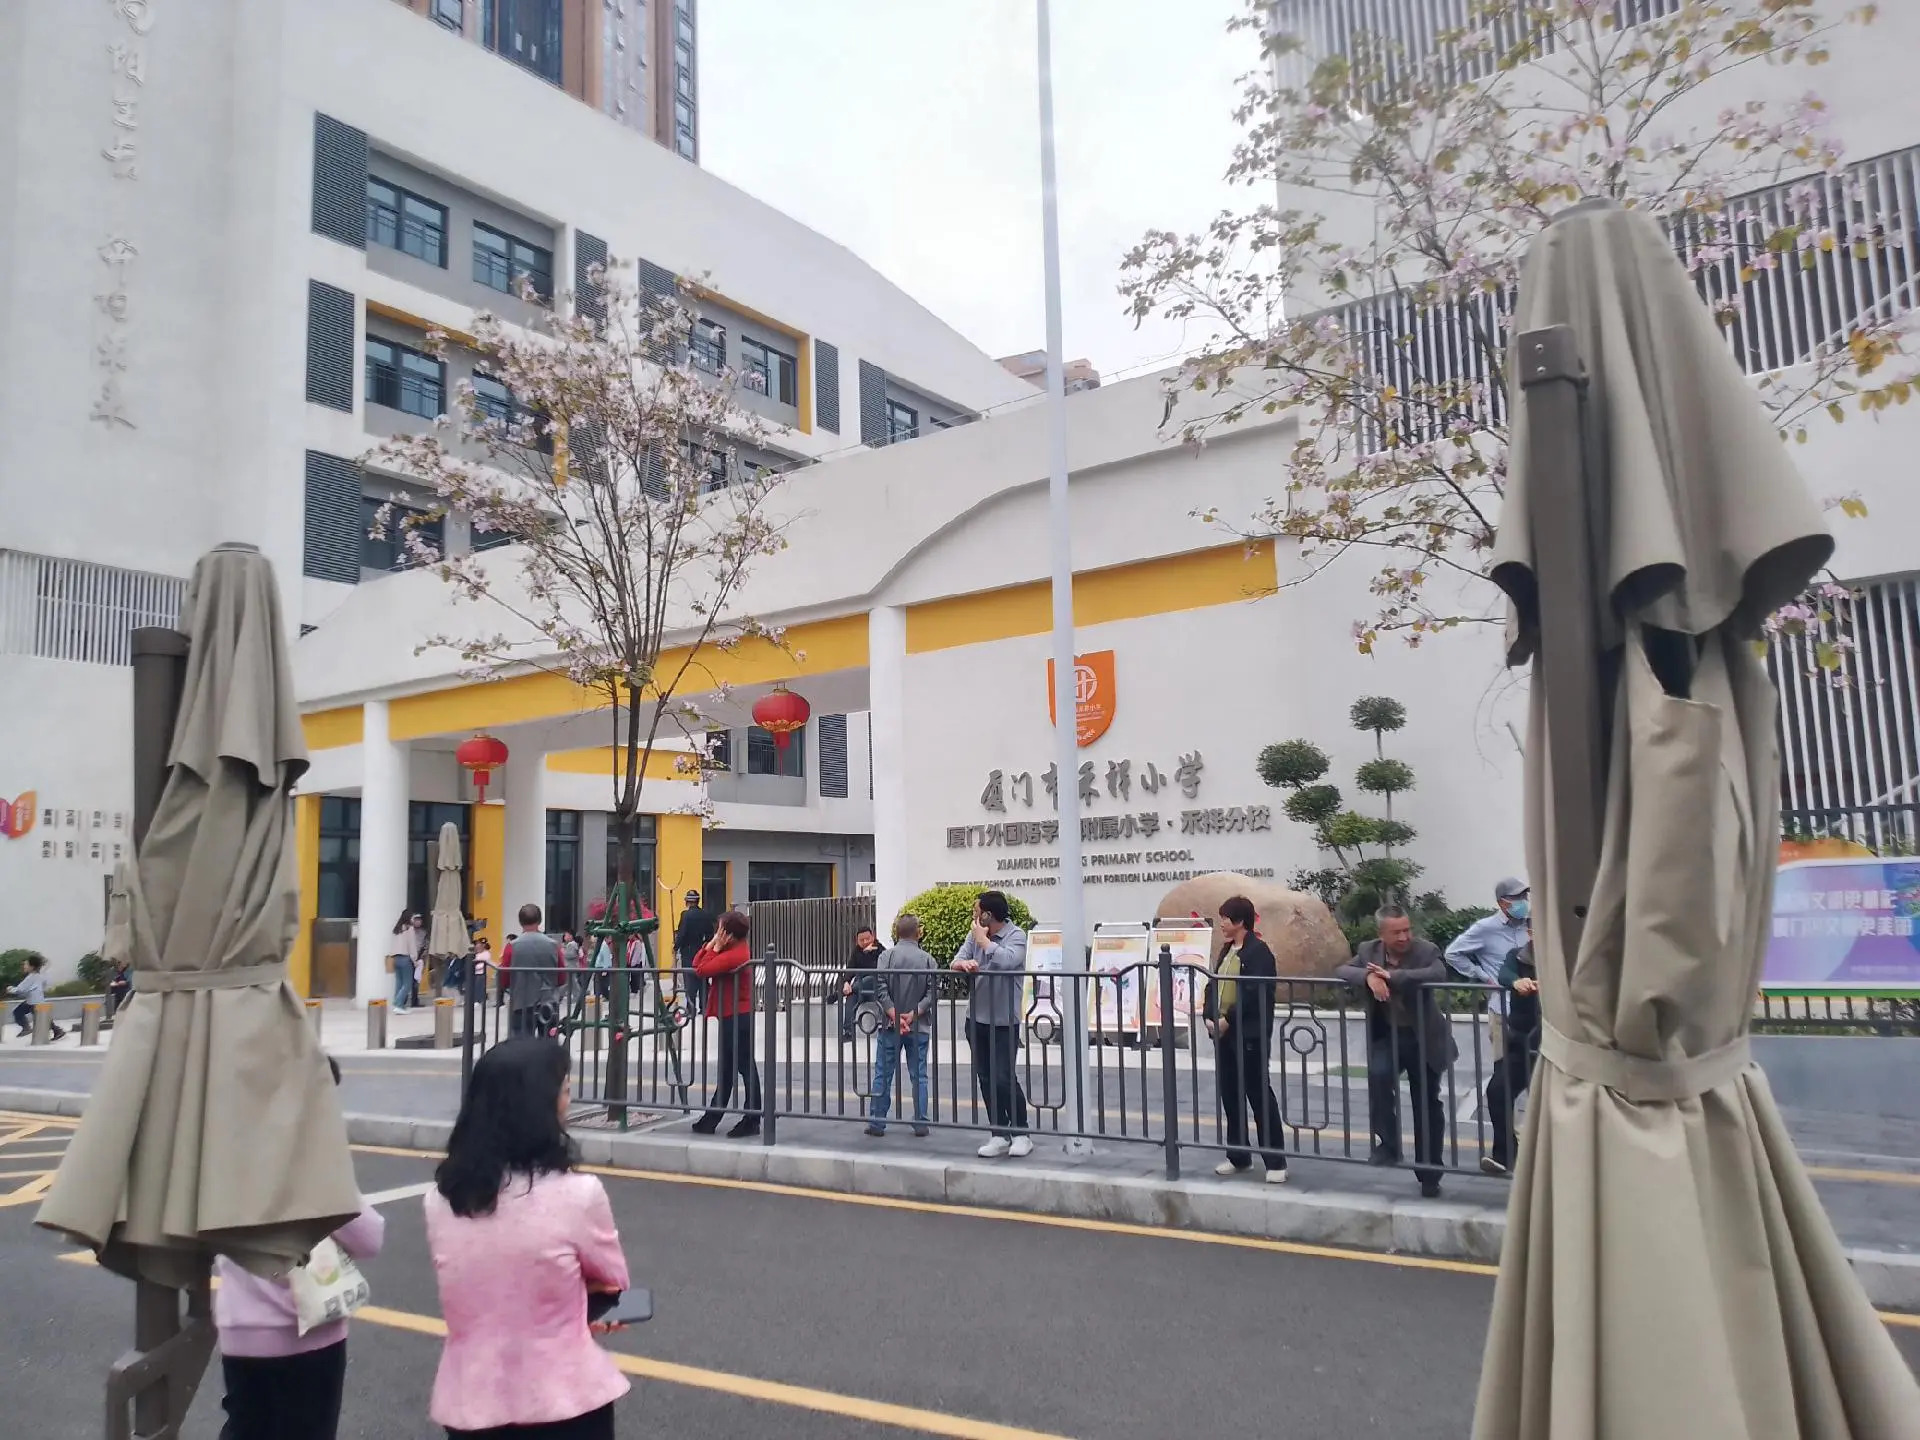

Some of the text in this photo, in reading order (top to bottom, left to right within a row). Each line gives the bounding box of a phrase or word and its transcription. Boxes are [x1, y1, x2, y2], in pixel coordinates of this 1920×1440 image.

[997, 857, 1038, 870] XIAMEN
[1091, 852, 1142, 867] PRIMARY
[1145, 849, 1195, 864] SCHOOL
[1015, 876, 1056, 887] ATTACHED
[1103, 872, 1141, 884] FOREIGN
[1142, 870, 1191, 882] LANGUAGE
